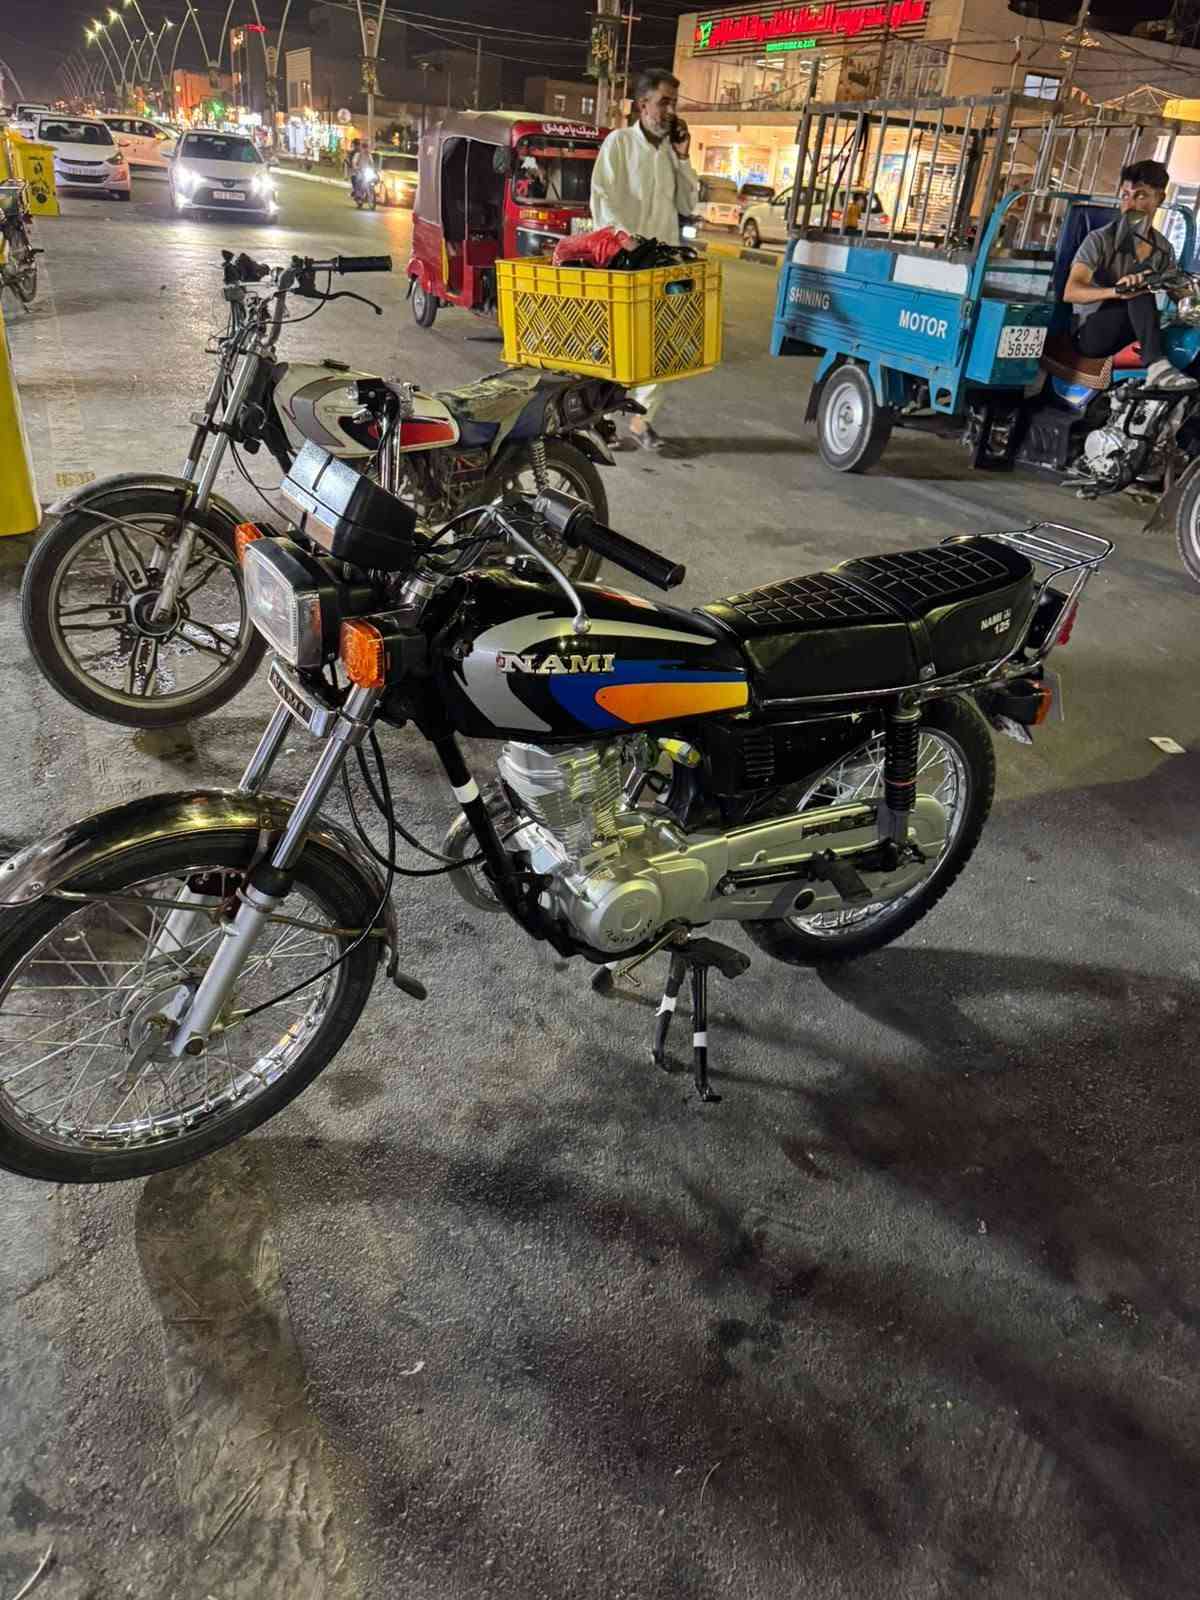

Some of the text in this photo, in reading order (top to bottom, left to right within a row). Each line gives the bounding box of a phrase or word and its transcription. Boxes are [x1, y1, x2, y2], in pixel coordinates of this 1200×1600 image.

[789, 287, 949, 339] SHINING MOTOR
[994, 618, 1010, 634] 125
[502, 654, 616, 674] NAMI
